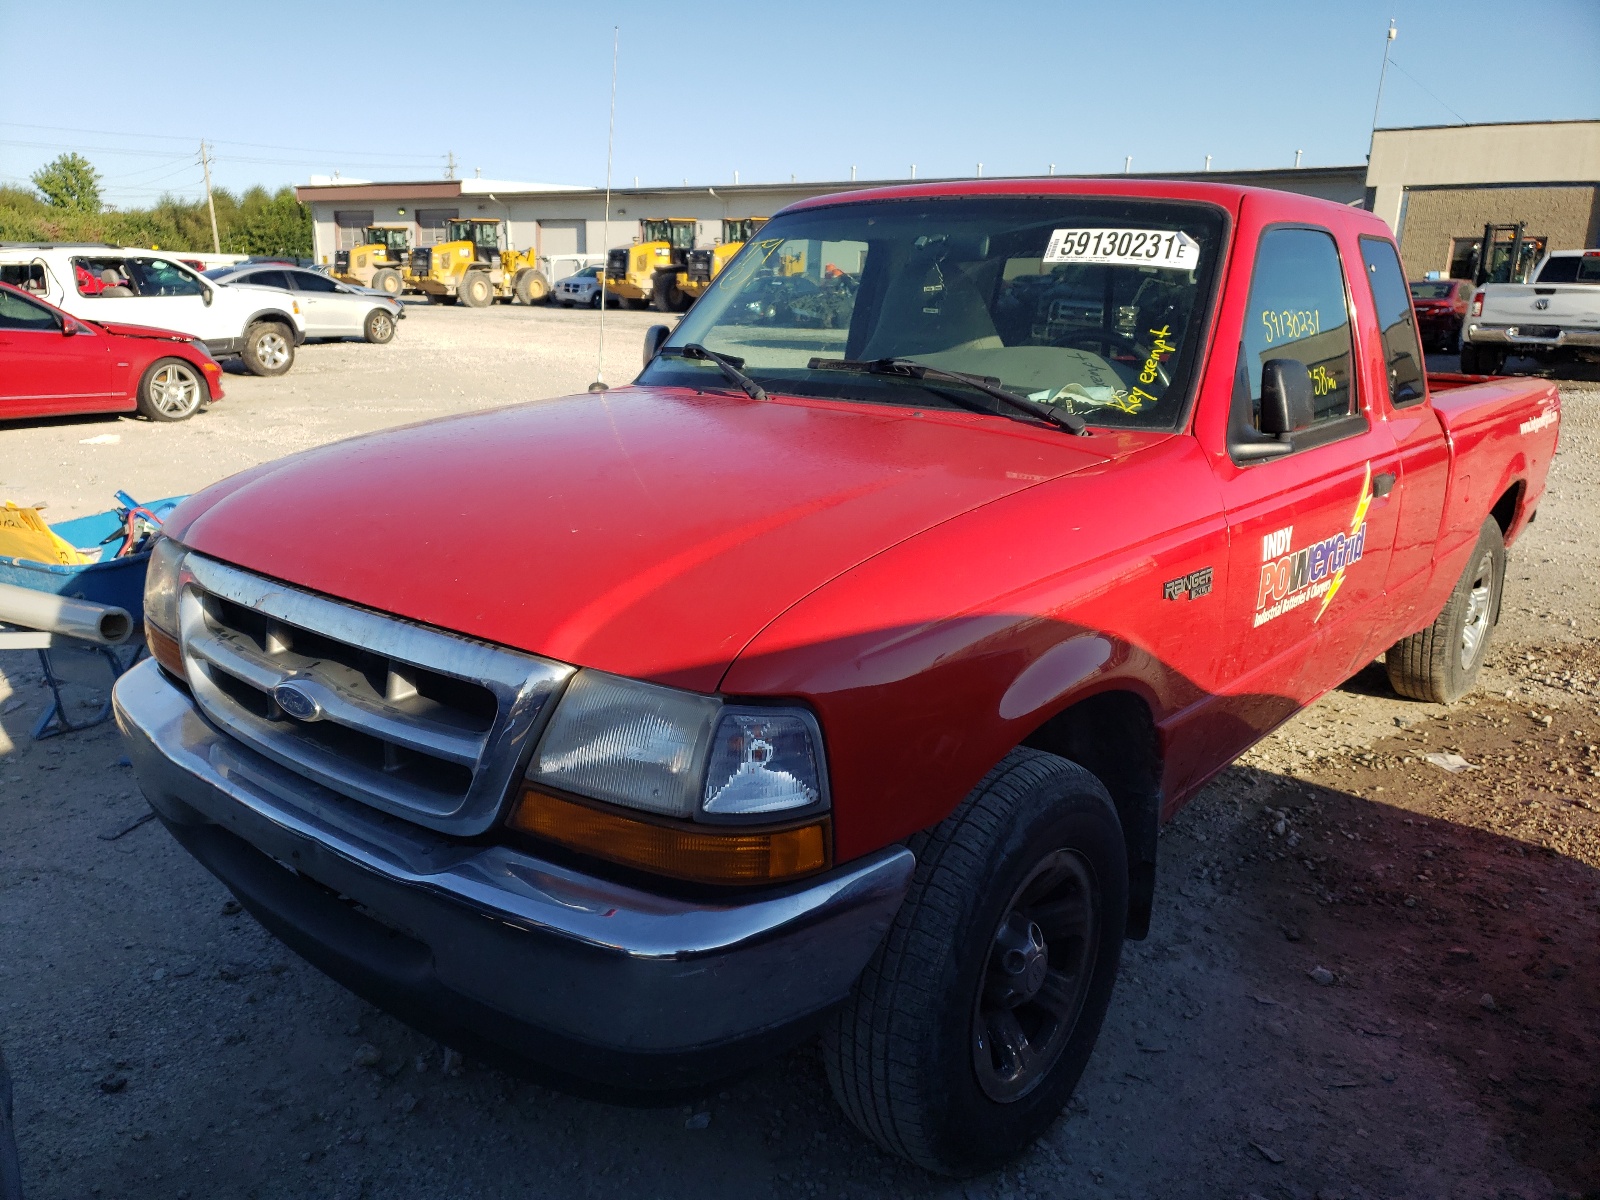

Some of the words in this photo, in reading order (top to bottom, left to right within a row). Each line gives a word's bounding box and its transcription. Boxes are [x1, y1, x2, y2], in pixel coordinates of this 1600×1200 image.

[1060, 231, 1176, 259] 59130231
[1176, 244, 1187, 258] E
[1262, 309, 1320, 343] 59130231
[1106, 386, 1158, 415] Key
[1139, 325, 1176, 384] exempt
[1263, 526, 1293, 562] INDY
[1194, 585, 1211, 597] XLT
[1253, 601, 1283, 628] Industrial
[1281, 590, 1307, 613] Batteries
[1310, 579, 1332, 599] Chargers
